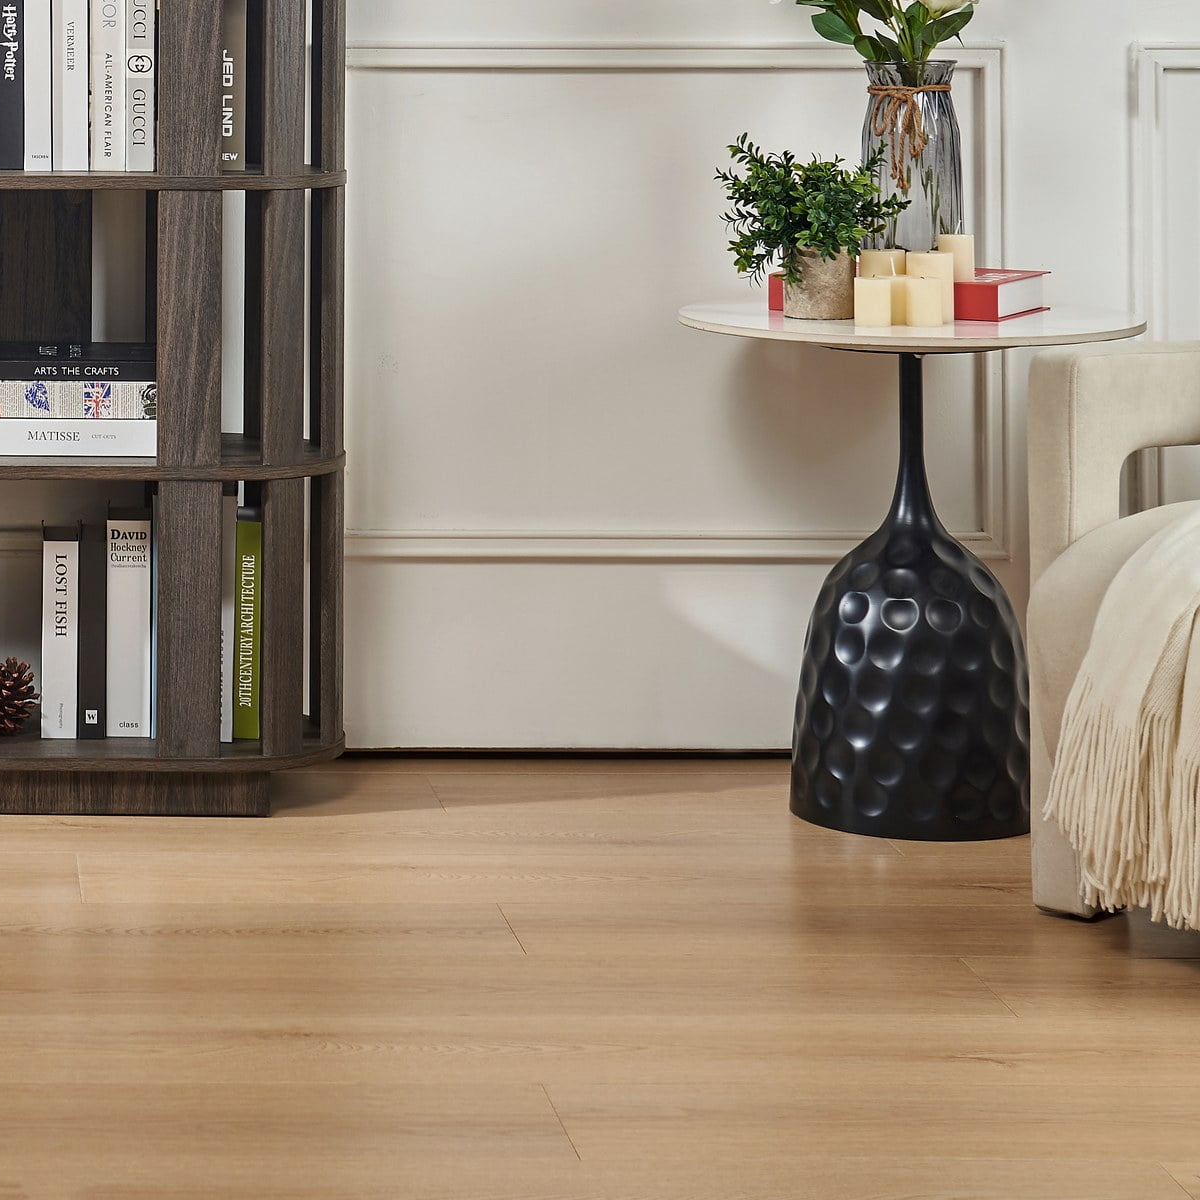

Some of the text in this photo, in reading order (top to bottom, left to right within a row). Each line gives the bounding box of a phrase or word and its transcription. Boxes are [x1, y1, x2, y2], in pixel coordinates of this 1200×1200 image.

[0, 3, 19, 80] Harry Potter
[66, 21, 75, 72] VERMEER
[104, 52, 113, 158] ALL-AMERICAN FLAIR
[132, 88, 146, 147] GUCCI
[222, 49, 233, 137] JED LIND
[33, 366, 119, 376] ARTS THE CRAFTS
[27, 430, 80, 442] MATISSE
[110, 543, 147, 553] Hockney
[110, 553, 147, 562] Current
[55, 554, 68, 637] LOST FISH
